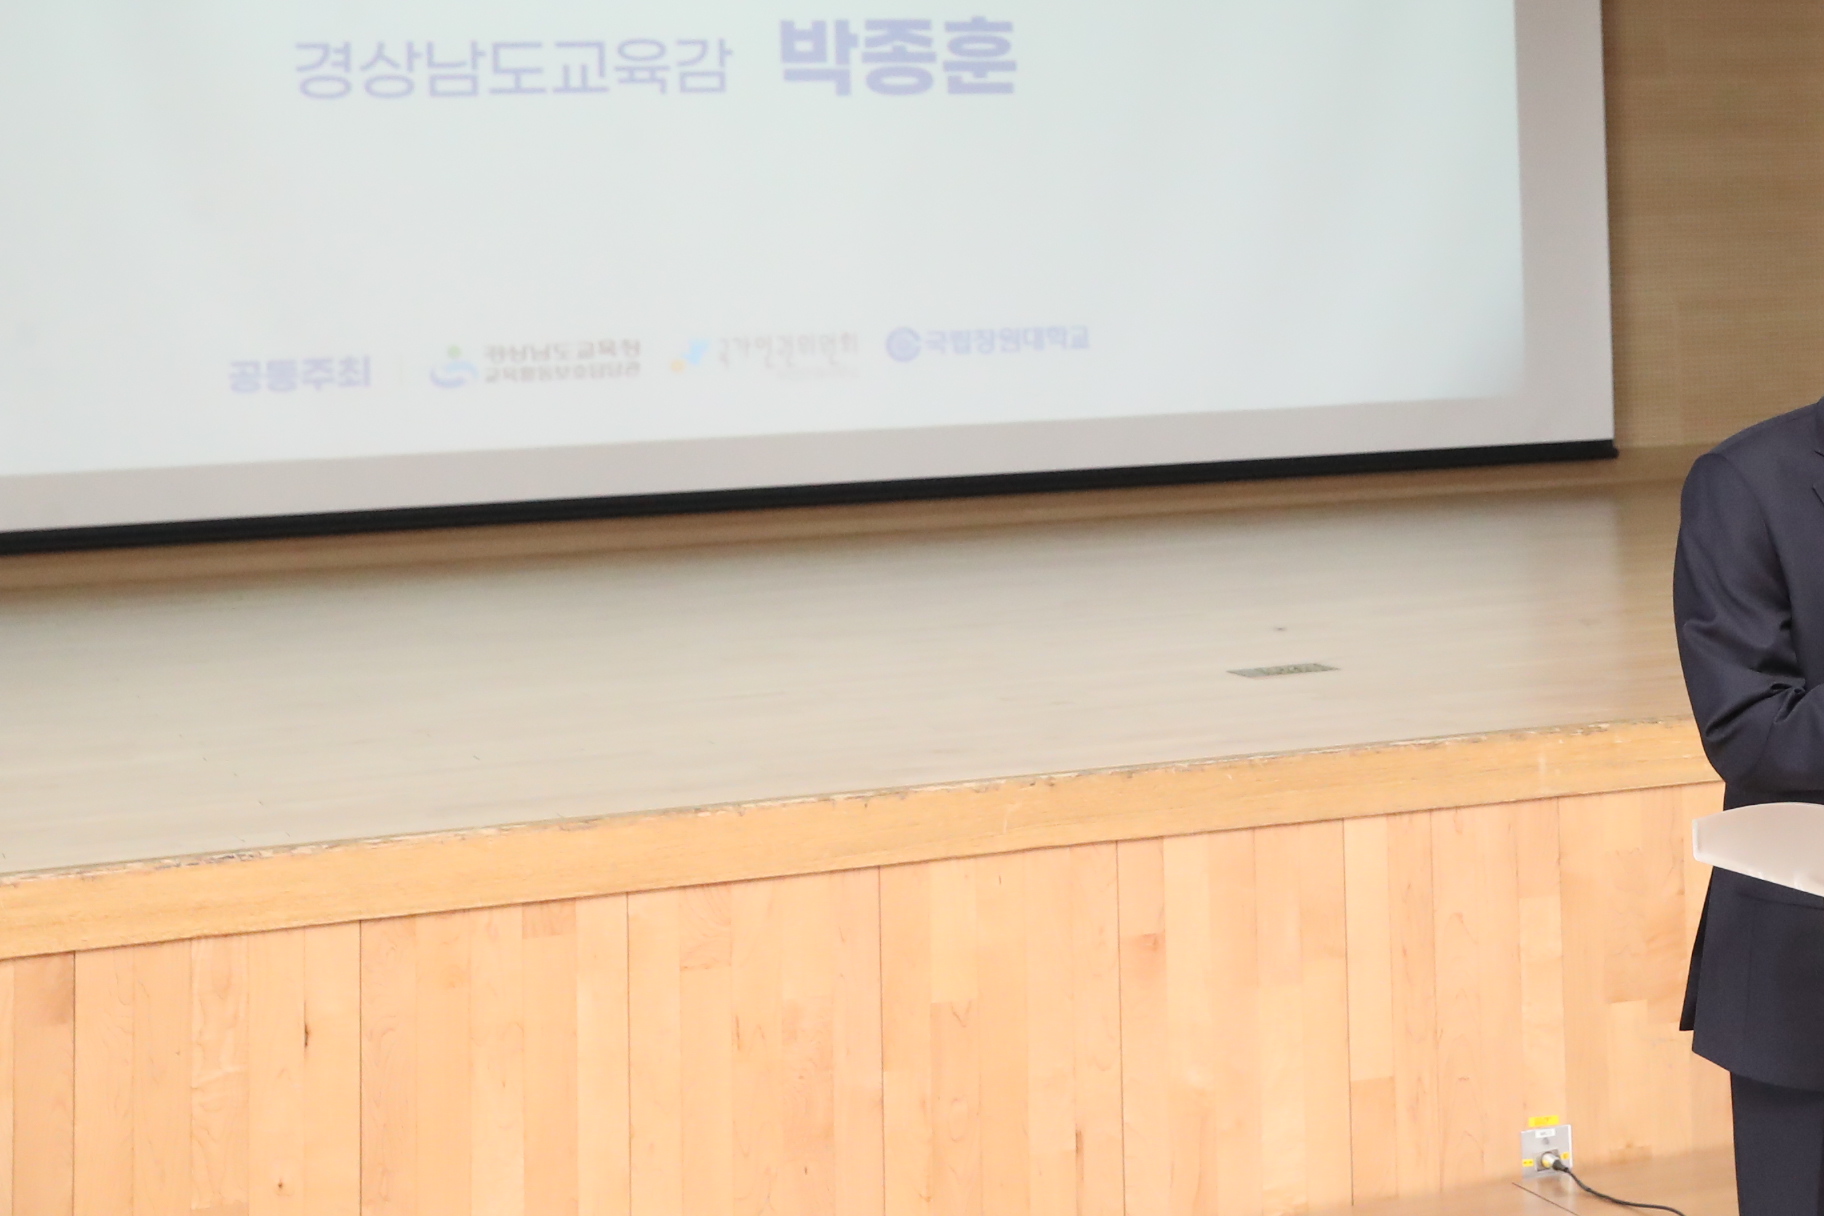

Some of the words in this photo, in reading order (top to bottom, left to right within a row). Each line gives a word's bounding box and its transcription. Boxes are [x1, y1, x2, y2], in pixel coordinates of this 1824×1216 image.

[294, 37, 735, 100] 경상남도교육감
[778, 14, 1019, 98] 박종훈
[229, 355, 372, 394] 공동주최
